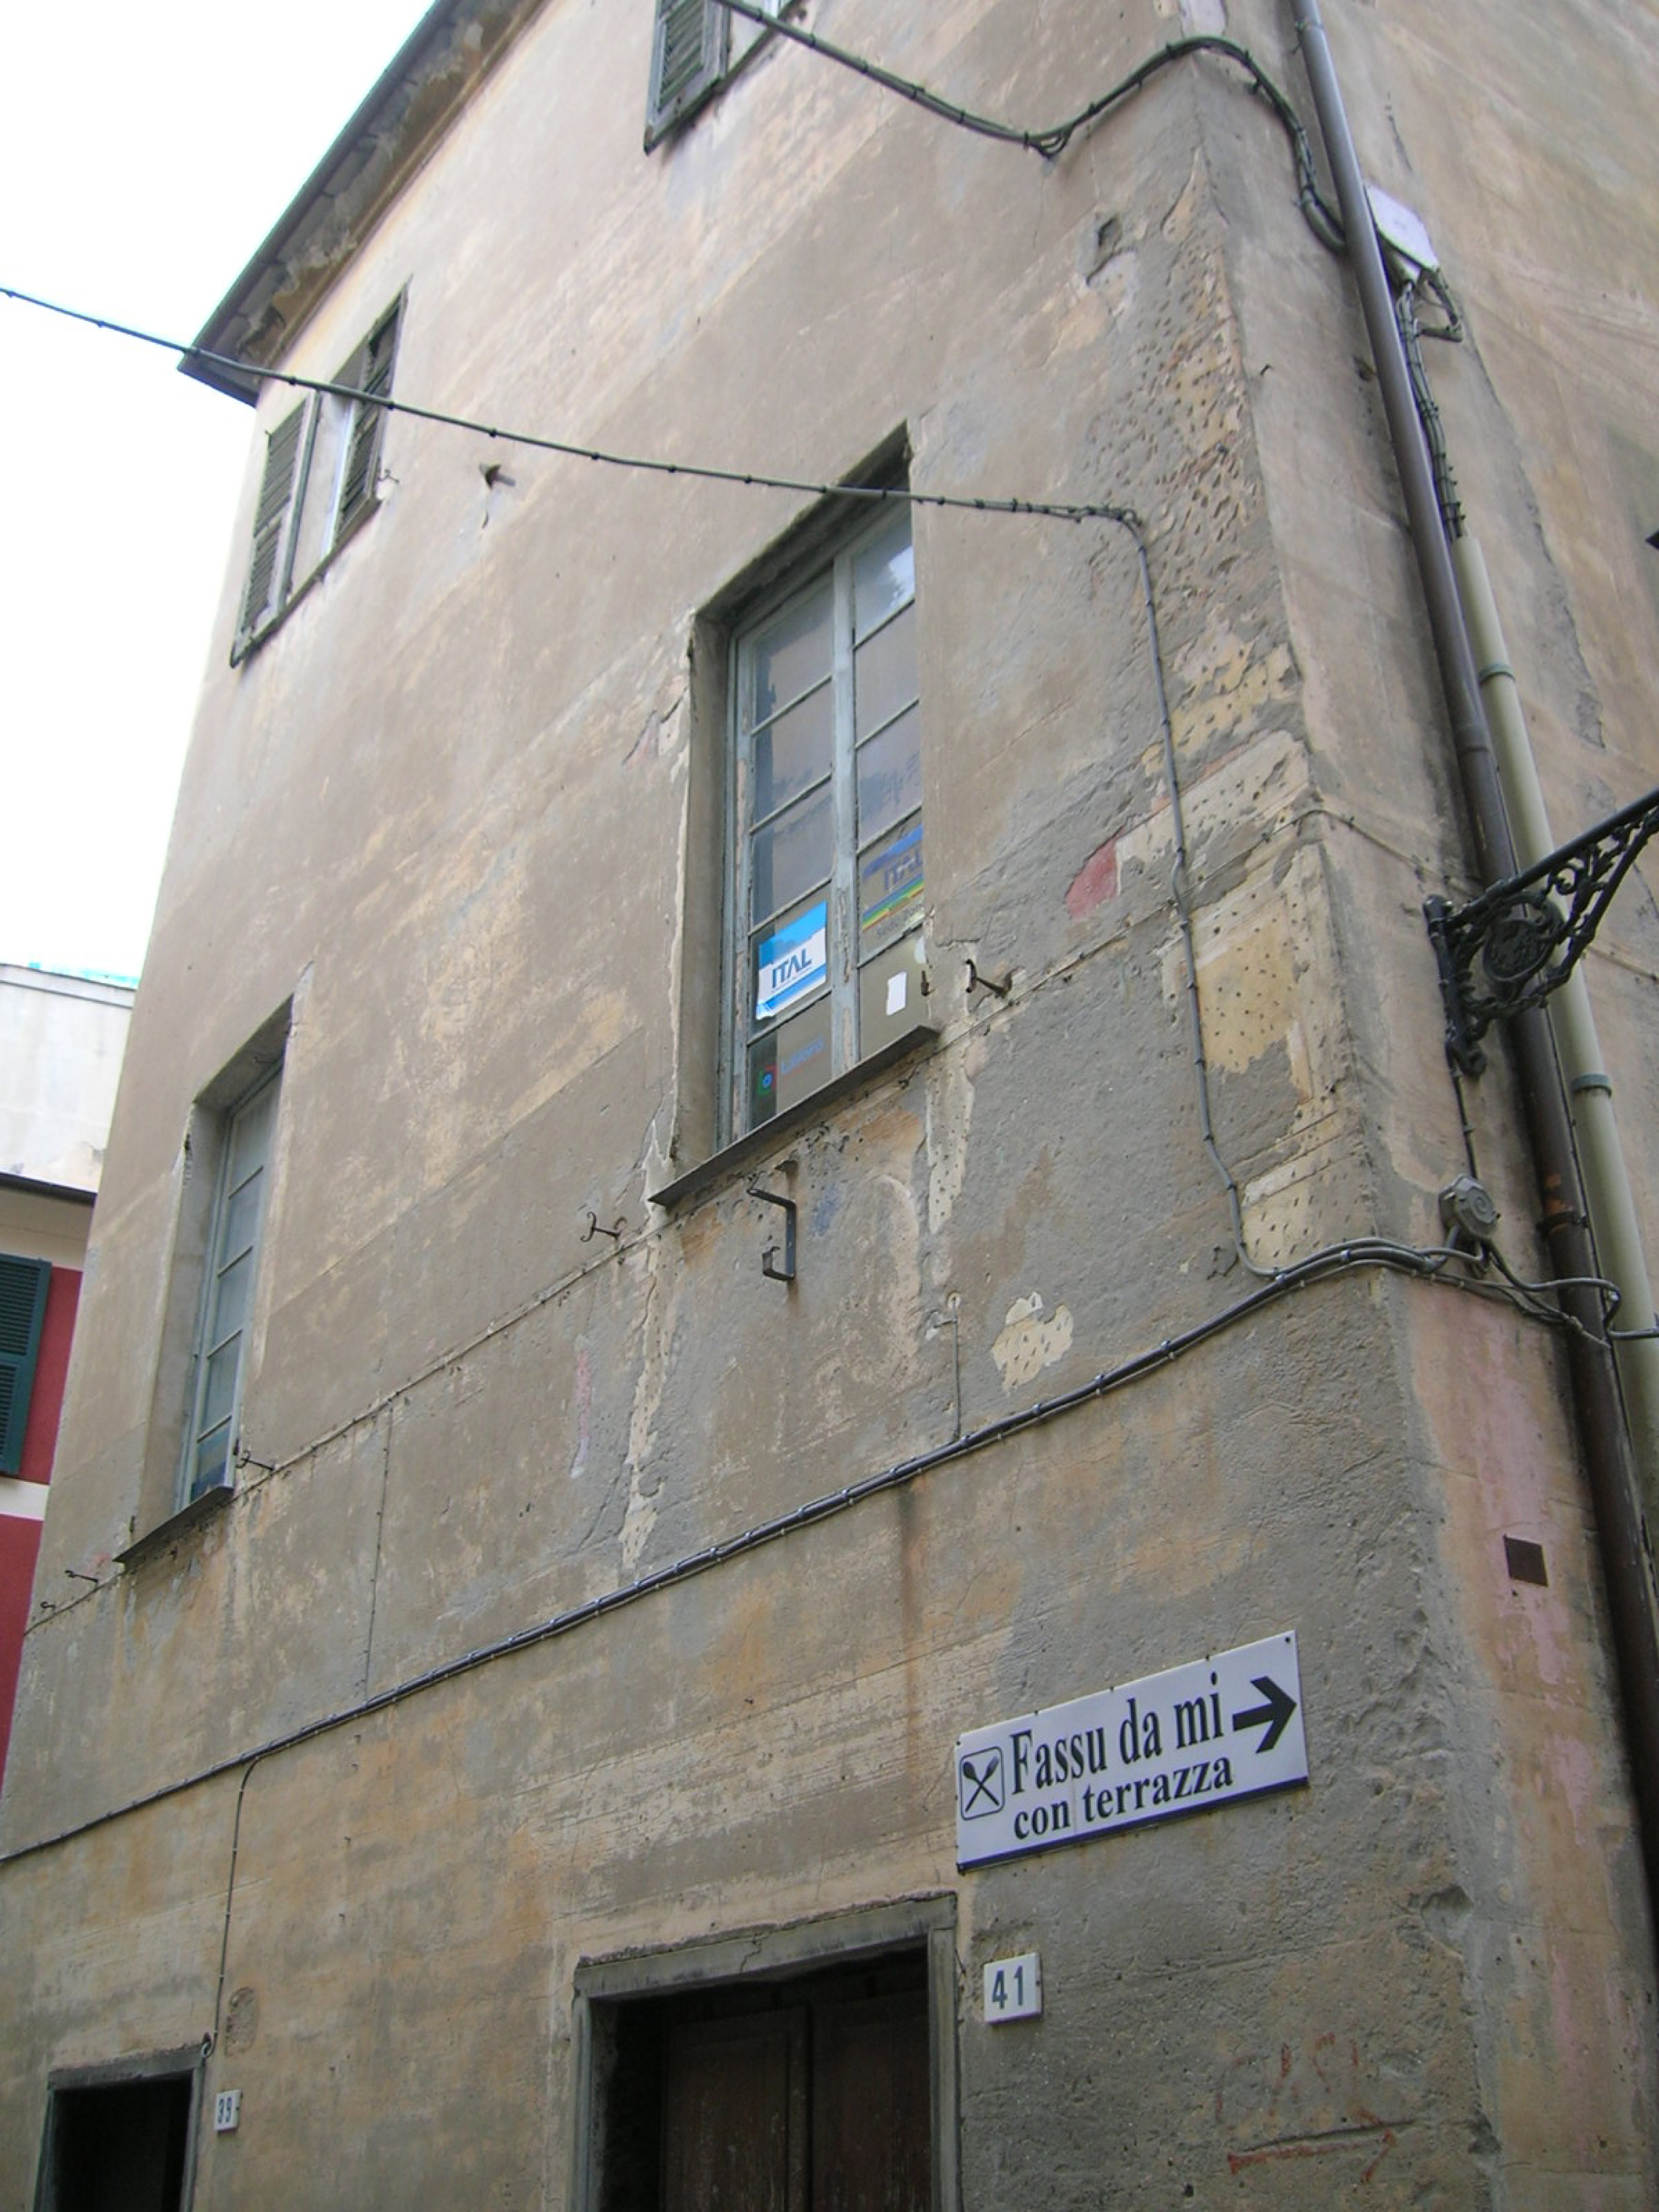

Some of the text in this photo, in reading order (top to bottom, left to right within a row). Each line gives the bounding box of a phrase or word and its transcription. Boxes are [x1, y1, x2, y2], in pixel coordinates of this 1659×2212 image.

[772, 949, 812, 988] ITAL
[1010, 1671, 1225, 1795] Fassu da mi
[1013, 1756, 1233, 1840] con terrazza
[992, 1966, 1023, 2009] 41
